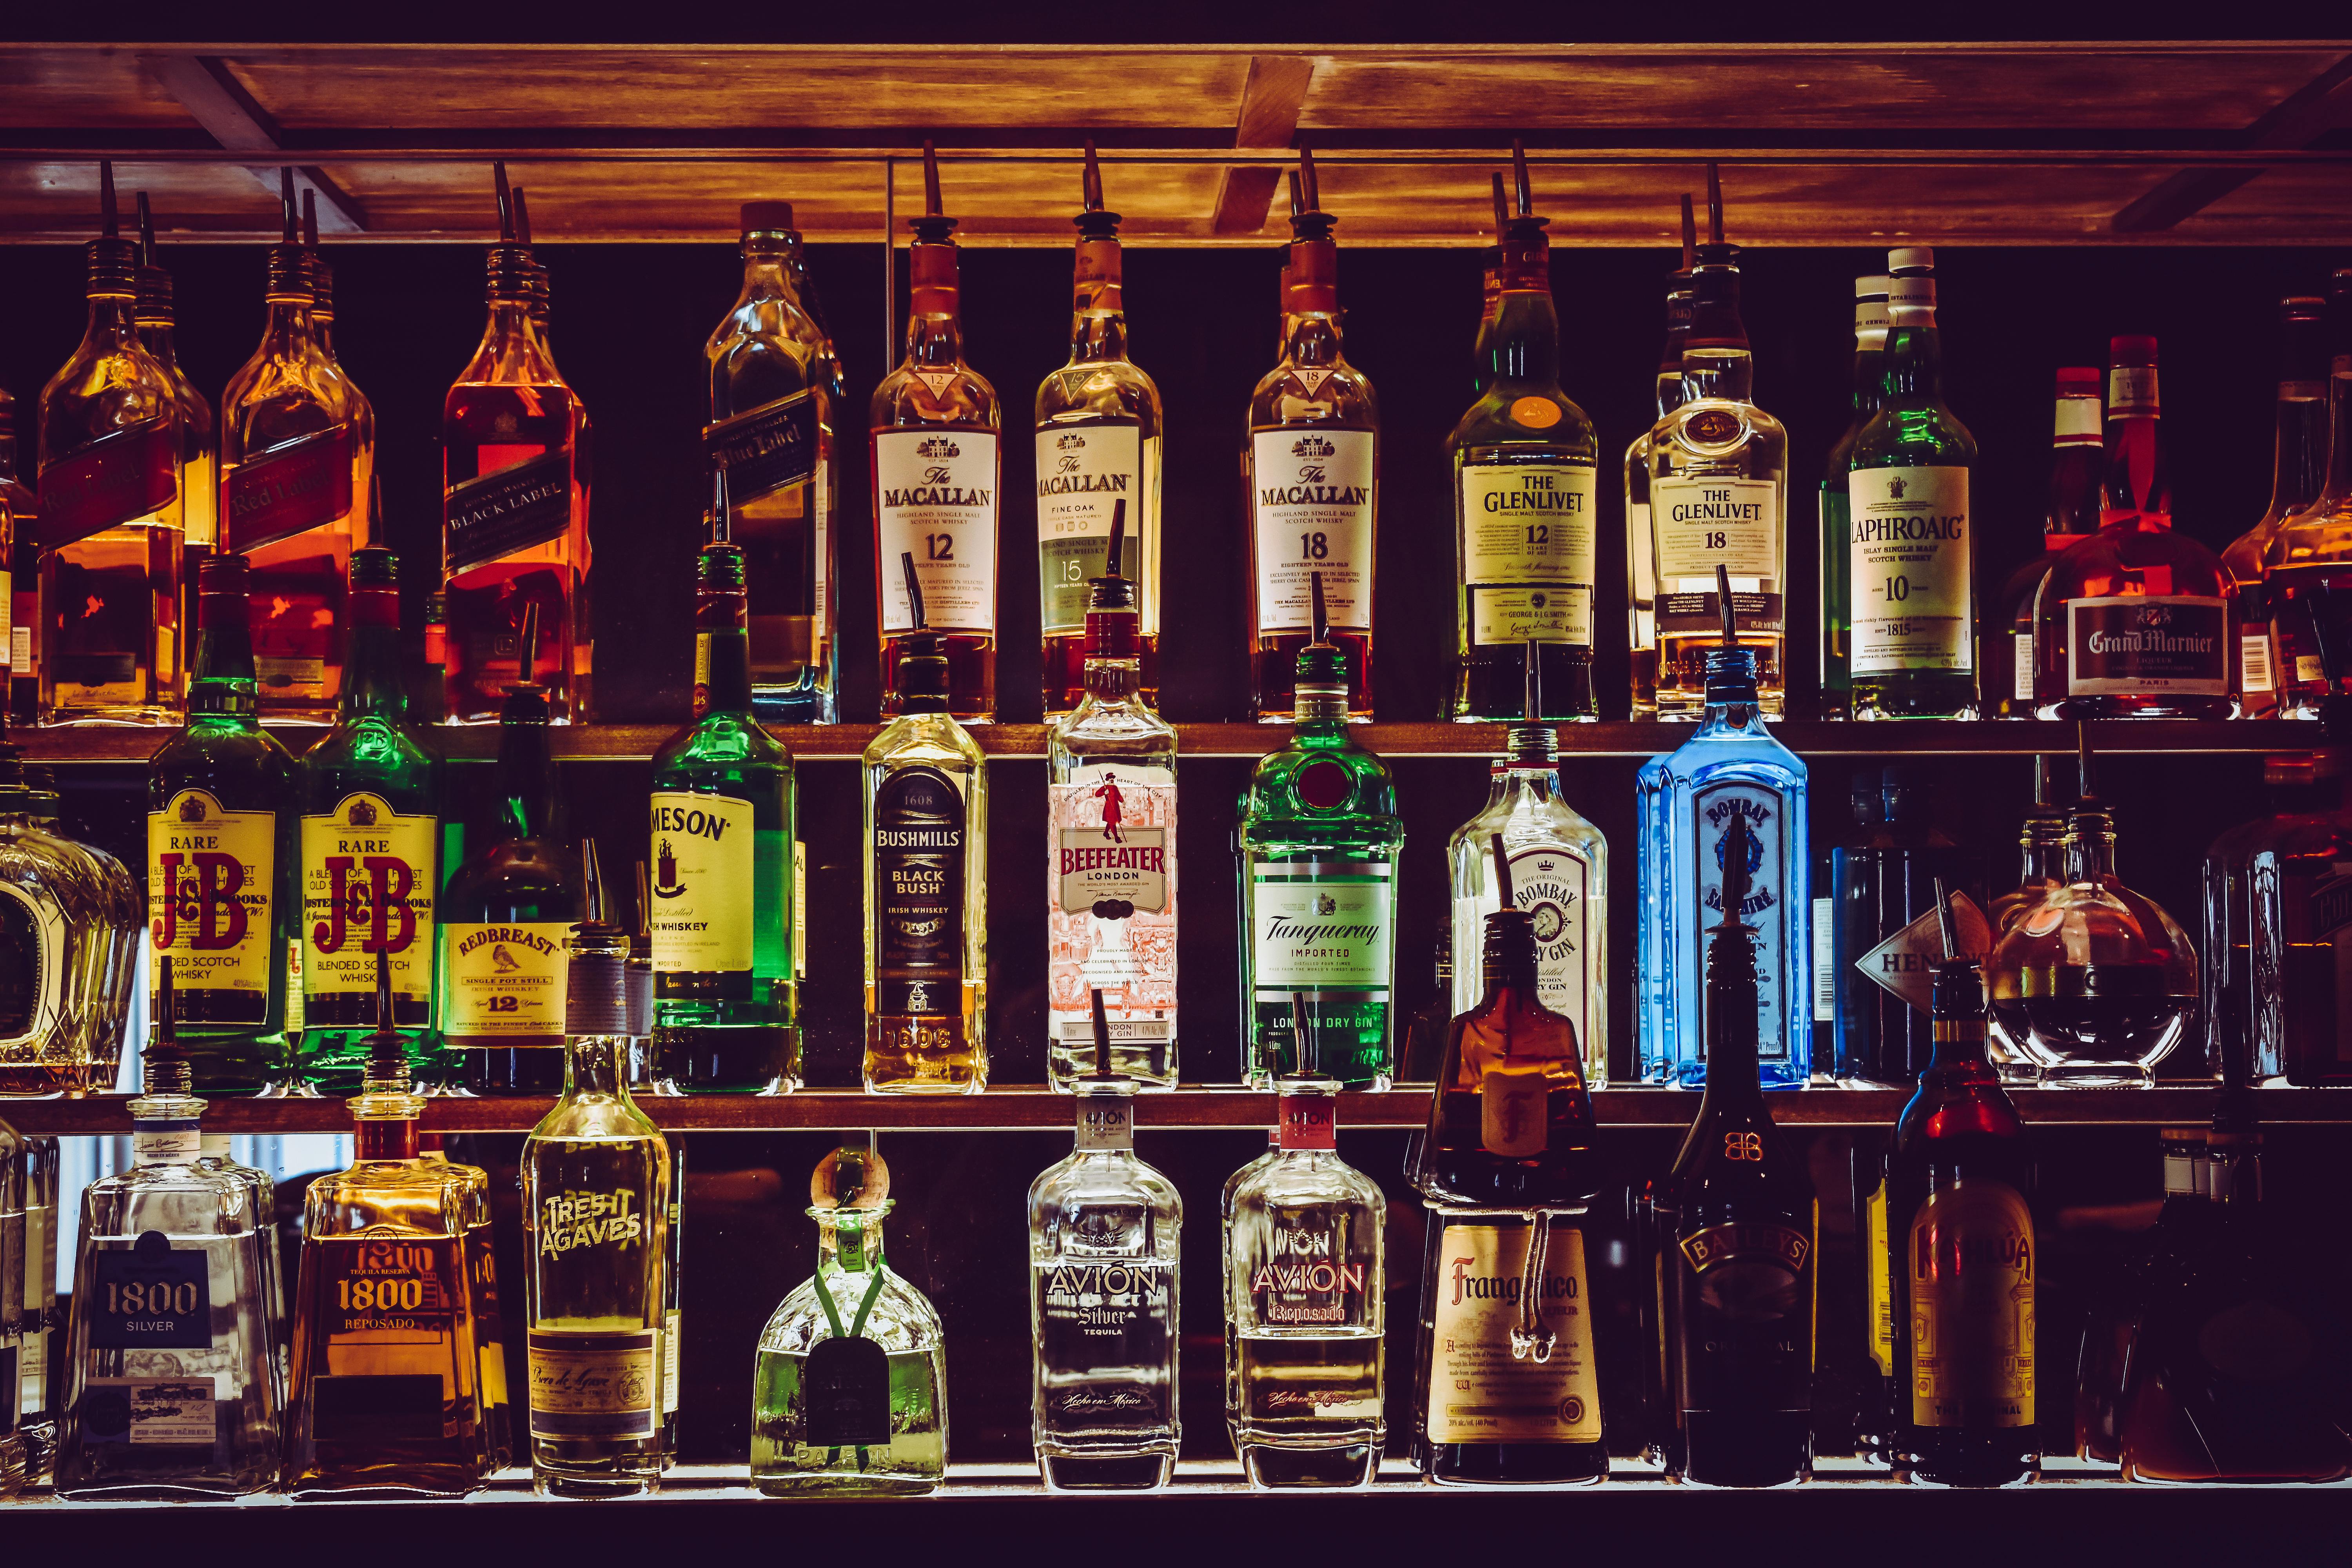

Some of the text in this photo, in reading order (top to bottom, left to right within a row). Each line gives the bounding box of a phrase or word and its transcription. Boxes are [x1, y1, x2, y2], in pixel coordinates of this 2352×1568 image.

[931, 375, 944, 384] 12
[1071, 373, 1085, 383] 15
[1305, 372, 1319, 381] 18
[756, 415, 789, 431] WALKER
[753, 423, 801, 457] Label
[1056, 456, 1080, 474] The
[921, 466, 951, 485] The
[1296, 465, 1326, 484] The
[1521, 476, 1553, 490] THE
[231, 468, 333, 516] Red Label
[503, 477, 537, 495] WALKER
[884, 487, 992, 508] MACALLAN
[1261, 486, 1369, 506] MACALLAN
[1484, 492, 1584, 513] GLENLIVET
[1702, 490, 1731, 501] THE
[450, 481, 562, 530] BLACK LABEL
[1525, 524, 1549, 544] 12
[1852, 515, 1962, 544] LAPHROAIG
[926, 533, 954, 561] 12
[1301, 532, 1328, 560] 18
[1704, 532, 1727, 549] 18
[1062, 561, 1081, 582] 15
[1886, 575, 1909, 601] 10
[1887, 624, 1911, 636] 1815
[2089, 629, 2214, 654] Grand Marnier
[905, 795, 932, 805] 1608
[1064, 785, 1085, 802] DISTILLED
[1151, 789, 1162, 799] CITY
[1706, 798, 1771, 828] BOMBAY
[651, 807, 726, 842] MESON
[170, 836, 219, 849] RARE
[338, 840, 390, 853] RARE
[878, 830, 959, 847] BUSHMILLS
[1061, 847, 1166, 876] BEEFEATER
[348, 869, 363, 878] OF
[893, 871, 944, 882] BLACK
[1087, 871, 1139, 880] LONDON
[1522, 875, 1570, 885] THE ORIGINAL
[310, 881, 326, 890] OLD
[897, 884, 939, 894] BUSH
[1515, 882, 1577, 909] BOMBAY
[661, 922, 708, 931] WHISKEY
[1266, 915, 1379, 946] Tanqueray
[458, 927, 557, 957] REDBREAST
[1549, 937, 1577, 962] GIN
[192, 957, 240, 966] SCOTCH
[1291, 949, 1349, 957] IMPORTED
[318, 960, 360, 970] BLENDED
[172, 970, 211, 979] WHISKY
[488, 996, 518, 1012] 12
[1326, 1017, 1372, 1027] DRY GIN
[545, 1194, 606, 1234] TRES
[540, 1213, 641, 1261] AGAVES
[1691, 1229, 1801, 1261] BAILEYS
[1047, 1260, 1158, 1297] AVIÓN
[1252, 1258, 1365, 1294] AVIÓN
[1451, 1257, 1578, 1307] Frangico
[107, 1281, 197, 1315] 1800
[337, 1278, 423, 1310] 1800
[1077, 1307, 1126, 1326] Silver
[1270, 1303, 1346, 1325] Reposado
[126, 1321, 174, 1331] SILVER
[345, 1318, 415, 1329] REPOSADO
[1705, 1339, 1795, 1354] ORIGINAL
[1062, 1394, 1091, 1411] Hecho
[1104, 1393, 1142, 1409] México
[1269, 1391, 1298, 1409] Hecho
